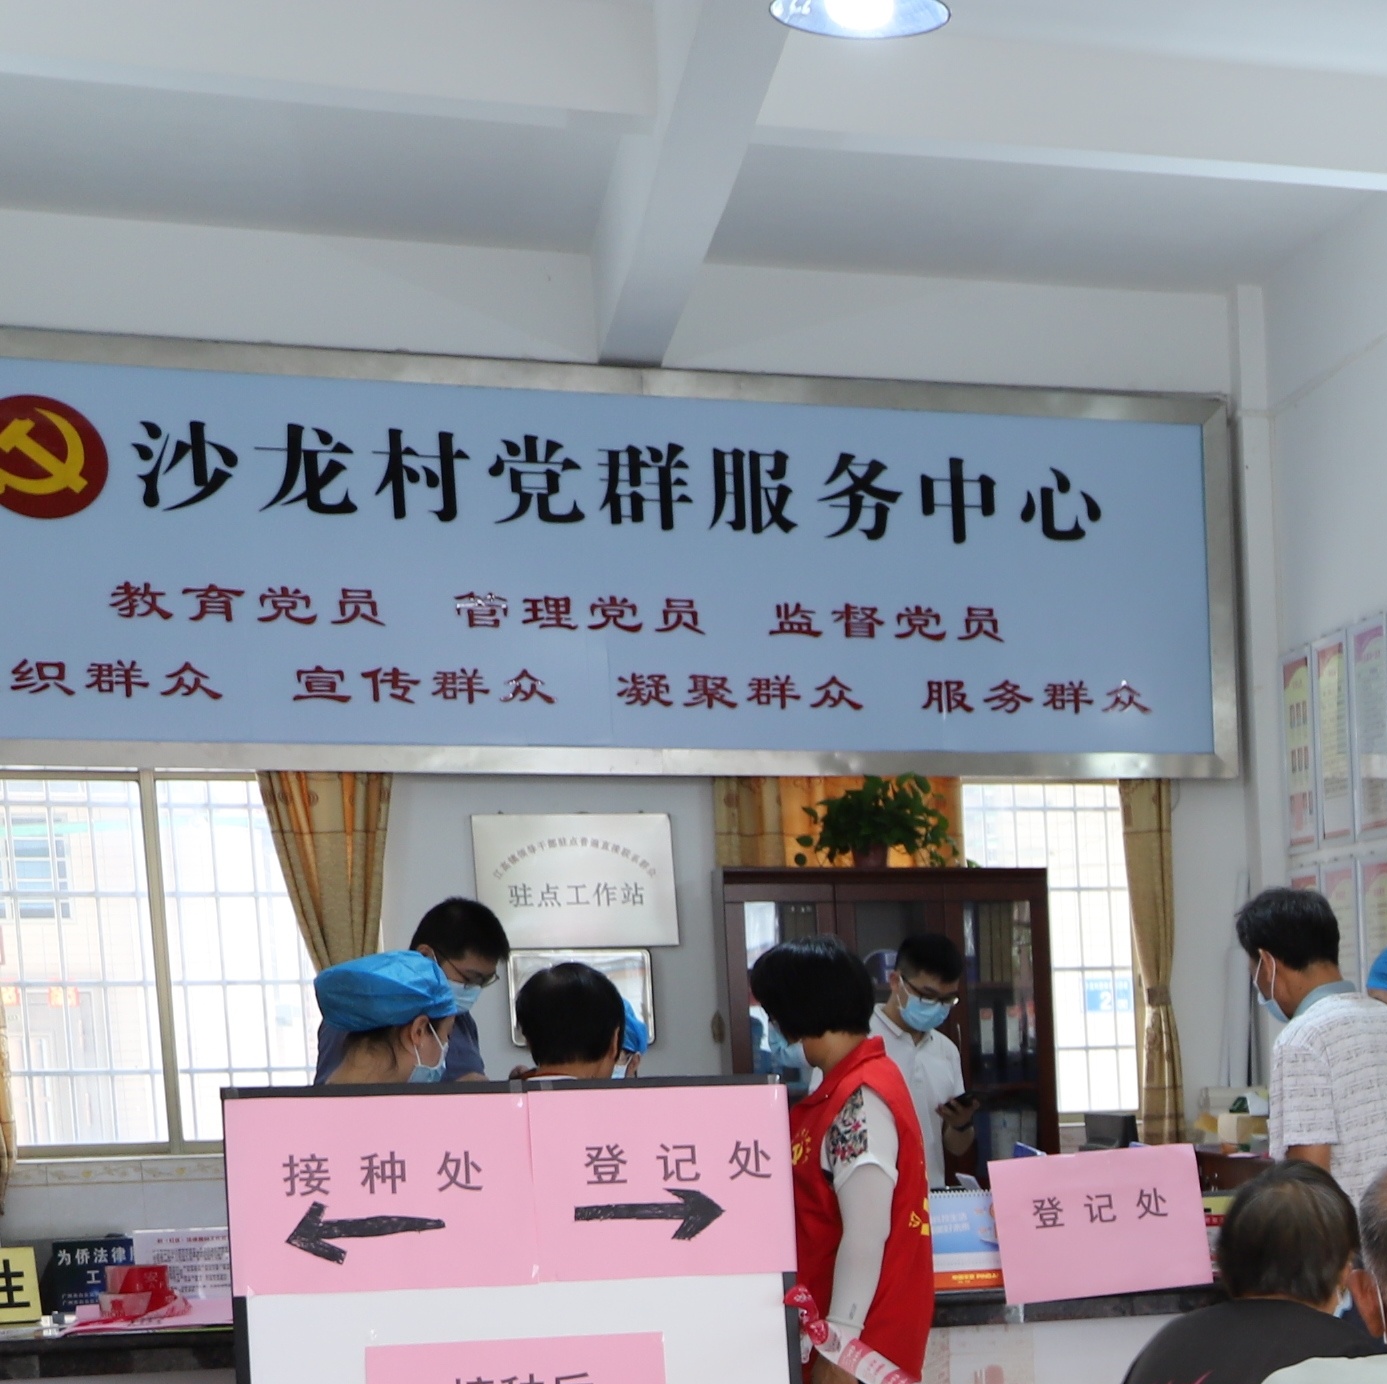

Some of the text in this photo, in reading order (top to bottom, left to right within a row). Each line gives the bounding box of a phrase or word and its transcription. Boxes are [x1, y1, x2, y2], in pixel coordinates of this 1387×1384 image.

[133, 419, 1104, 544] 沙龙村党群服务中心
[108, 581, 1005, 643] 教育党员 管理党员 监督党员
[10, 658, 1152, 714] 织群众 宣传群众 凝聚群众 服务群众
[508, 881, 645, 908] 驻点工作站
[281, 1151, 485, 1197] 接种处
[584, 1139, 773, 1187] 登记处
[1032, 1187, 1169, 1230] 登记处
[57, 1247, 134, 1266] 为侨法律
